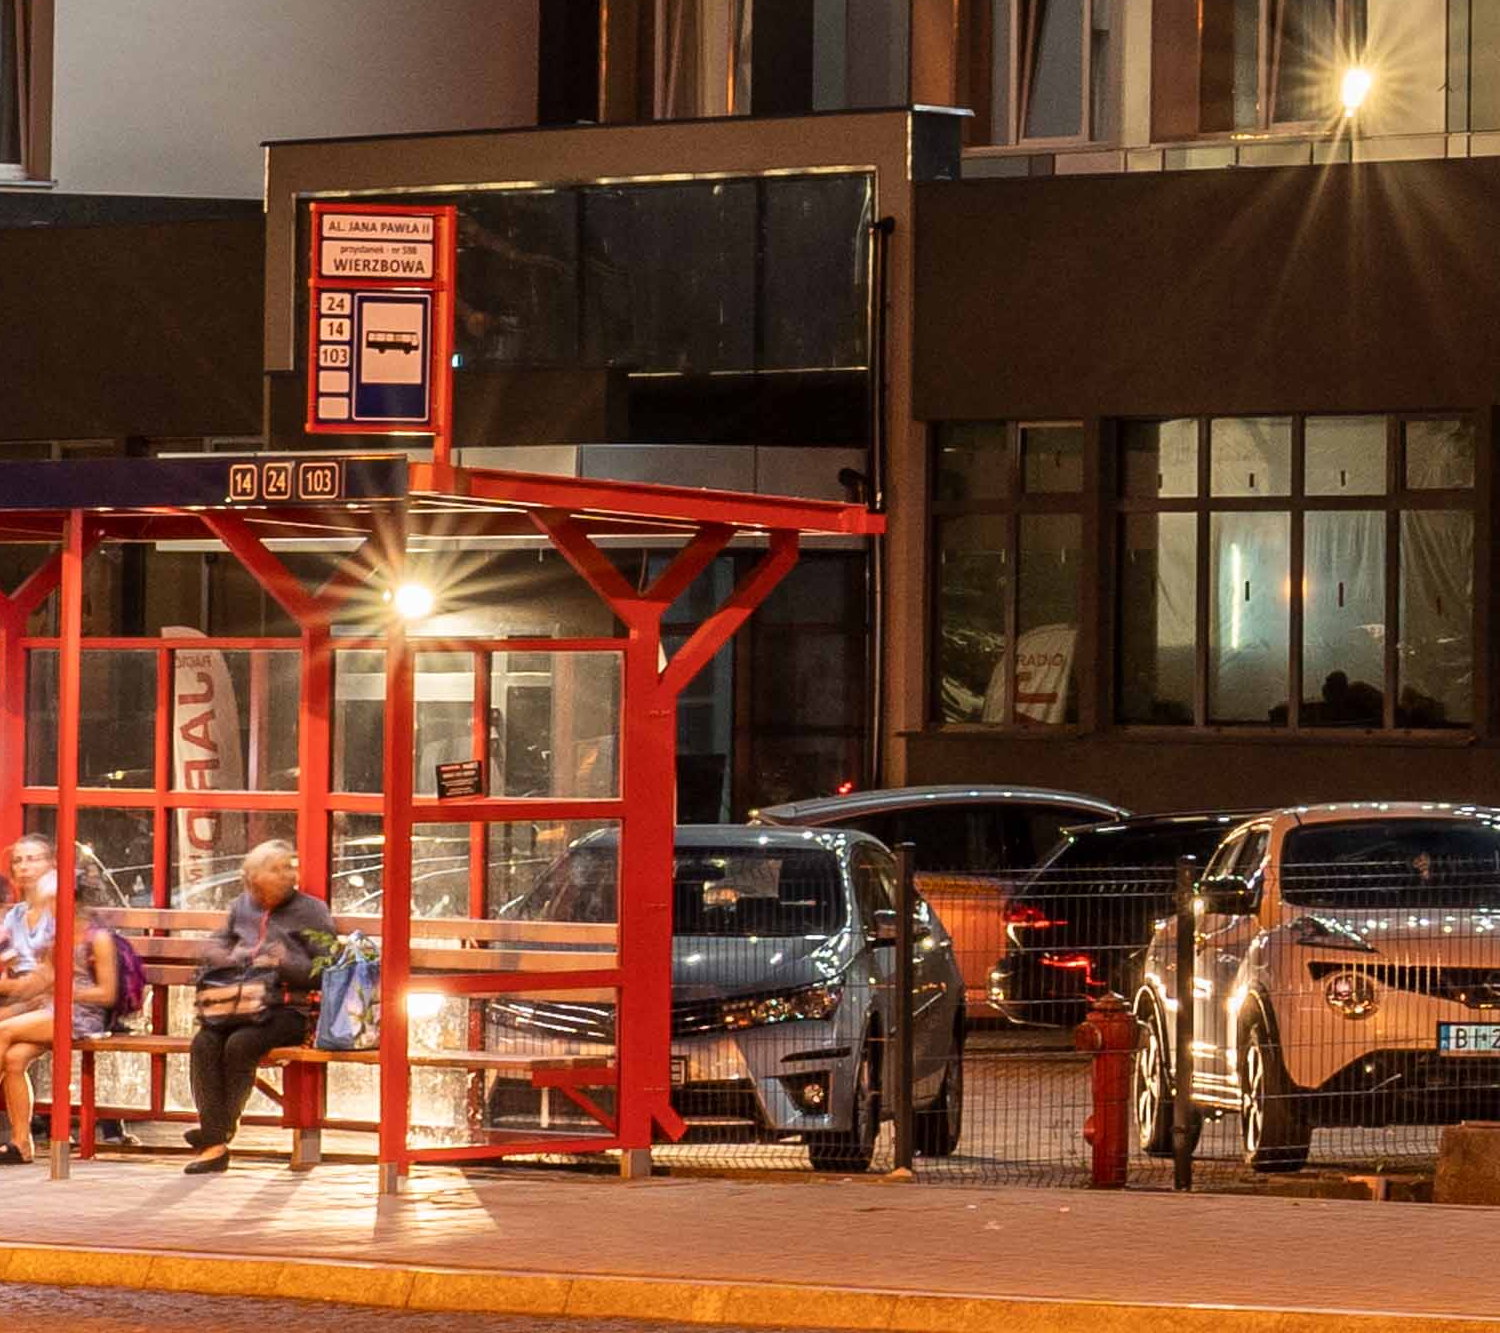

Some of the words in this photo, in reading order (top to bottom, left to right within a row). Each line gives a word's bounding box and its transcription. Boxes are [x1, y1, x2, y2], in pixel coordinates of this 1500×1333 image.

[348, 221, 378, 233] JANA
[333, 258, 426, 274] WIERZBOWA
[327, 296, 345, 311] 24
[328, 322, 344, 336] 14
[321, 348, 349, 364] 103
[235, 470, 252, 493] 14
[267, 470, 286, 493] 24
[306, 469, 332, 493] 103
[1454, 1028, 1479, 1049] BI
